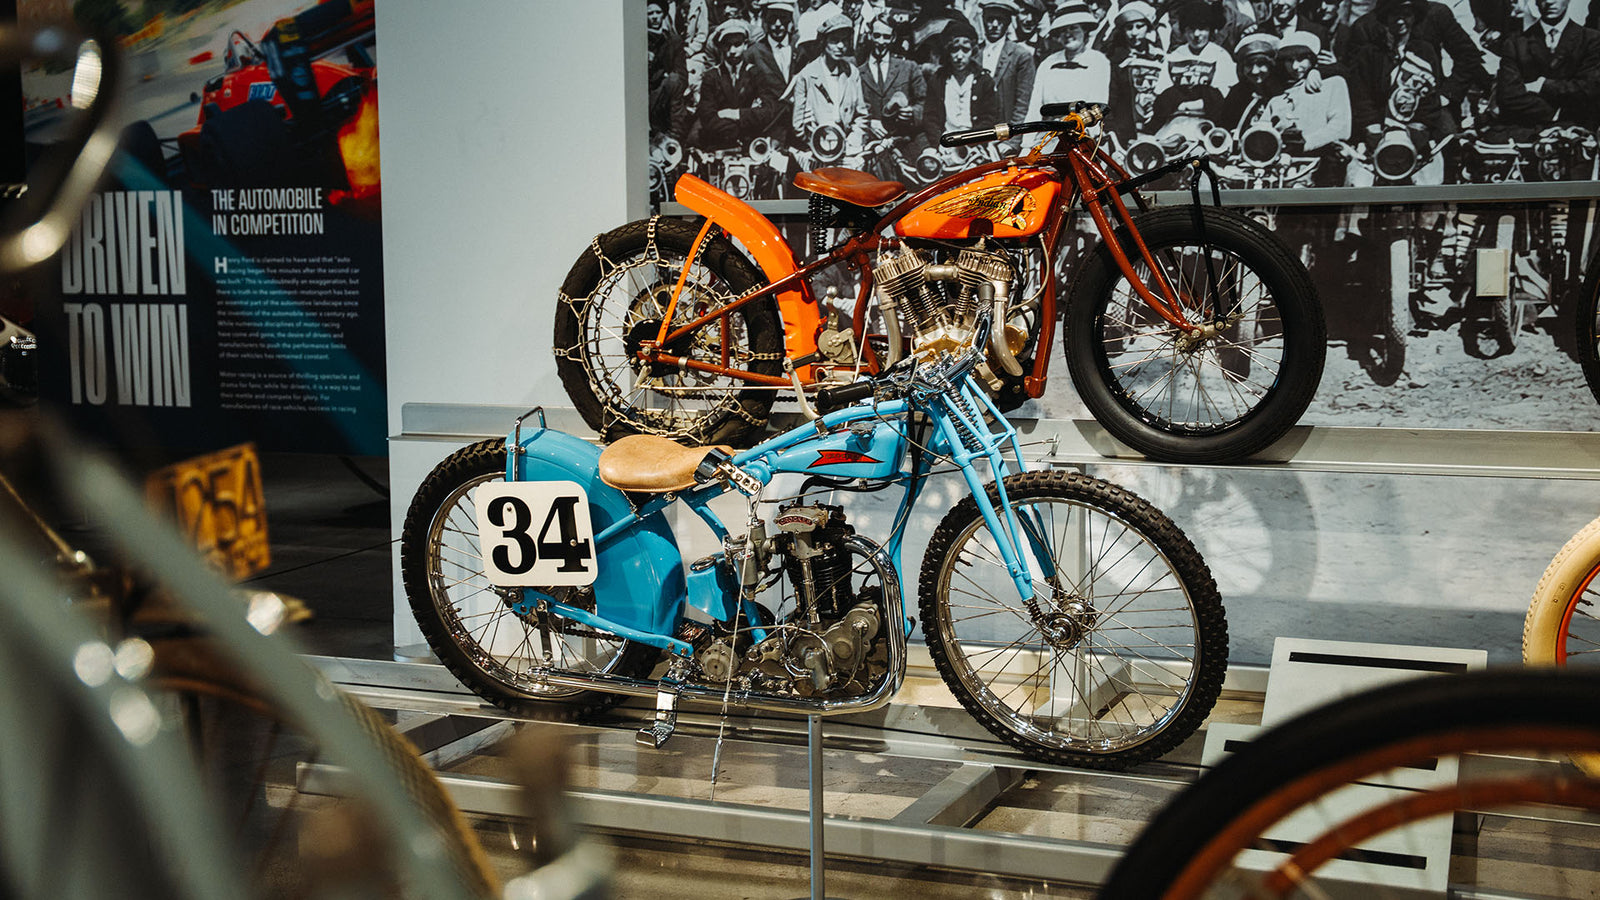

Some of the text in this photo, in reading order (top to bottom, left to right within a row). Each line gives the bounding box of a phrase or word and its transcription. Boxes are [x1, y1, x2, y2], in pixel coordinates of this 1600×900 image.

[211, 187, 322, 211] THE AUTOMOBILE
[213, 213, 324, 235] IN COMPETITION
[967, 195, 1007, 209] Indian
[62, 190, 186, 295] DRIVEN
[64, 303, 191, 407] TO WIN
[487, 496, 592, 574] 34
